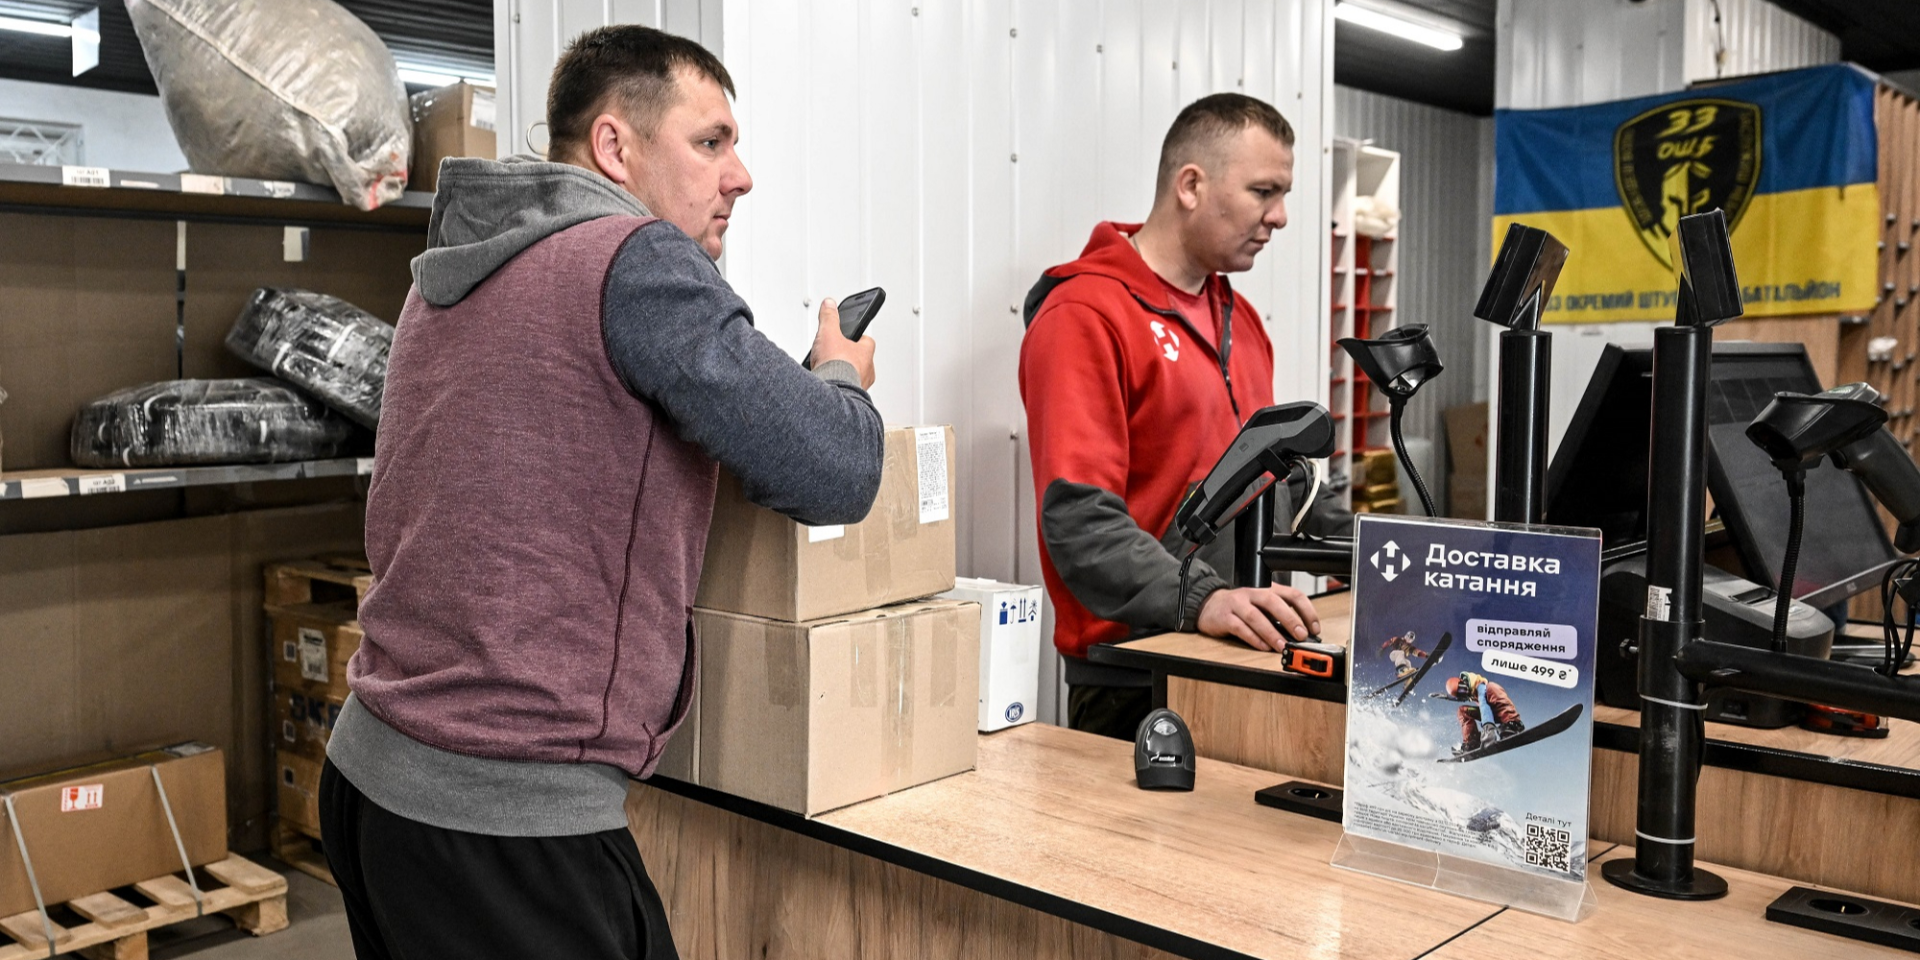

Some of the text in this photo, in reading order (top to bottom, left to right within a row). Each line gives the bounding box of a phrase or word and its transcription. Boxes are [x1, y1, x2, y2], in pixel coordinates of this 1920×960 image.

[1656, 106, 1719, 138] 33
[1566, 290, 1634, 311] ОКРЕМИЙ
[1425, 543, 1561, 575] Доставка
[1424, 571, 1537, 597] катання
[1477, 624, 1551, 638] відправляй
[1476, 639, 1566, 653] спорядження
[1490, 658, 1528, 672] лише
[1531, 665, 1555, 678] 499
[1525, 811, 1572, 828] Деталі тут
